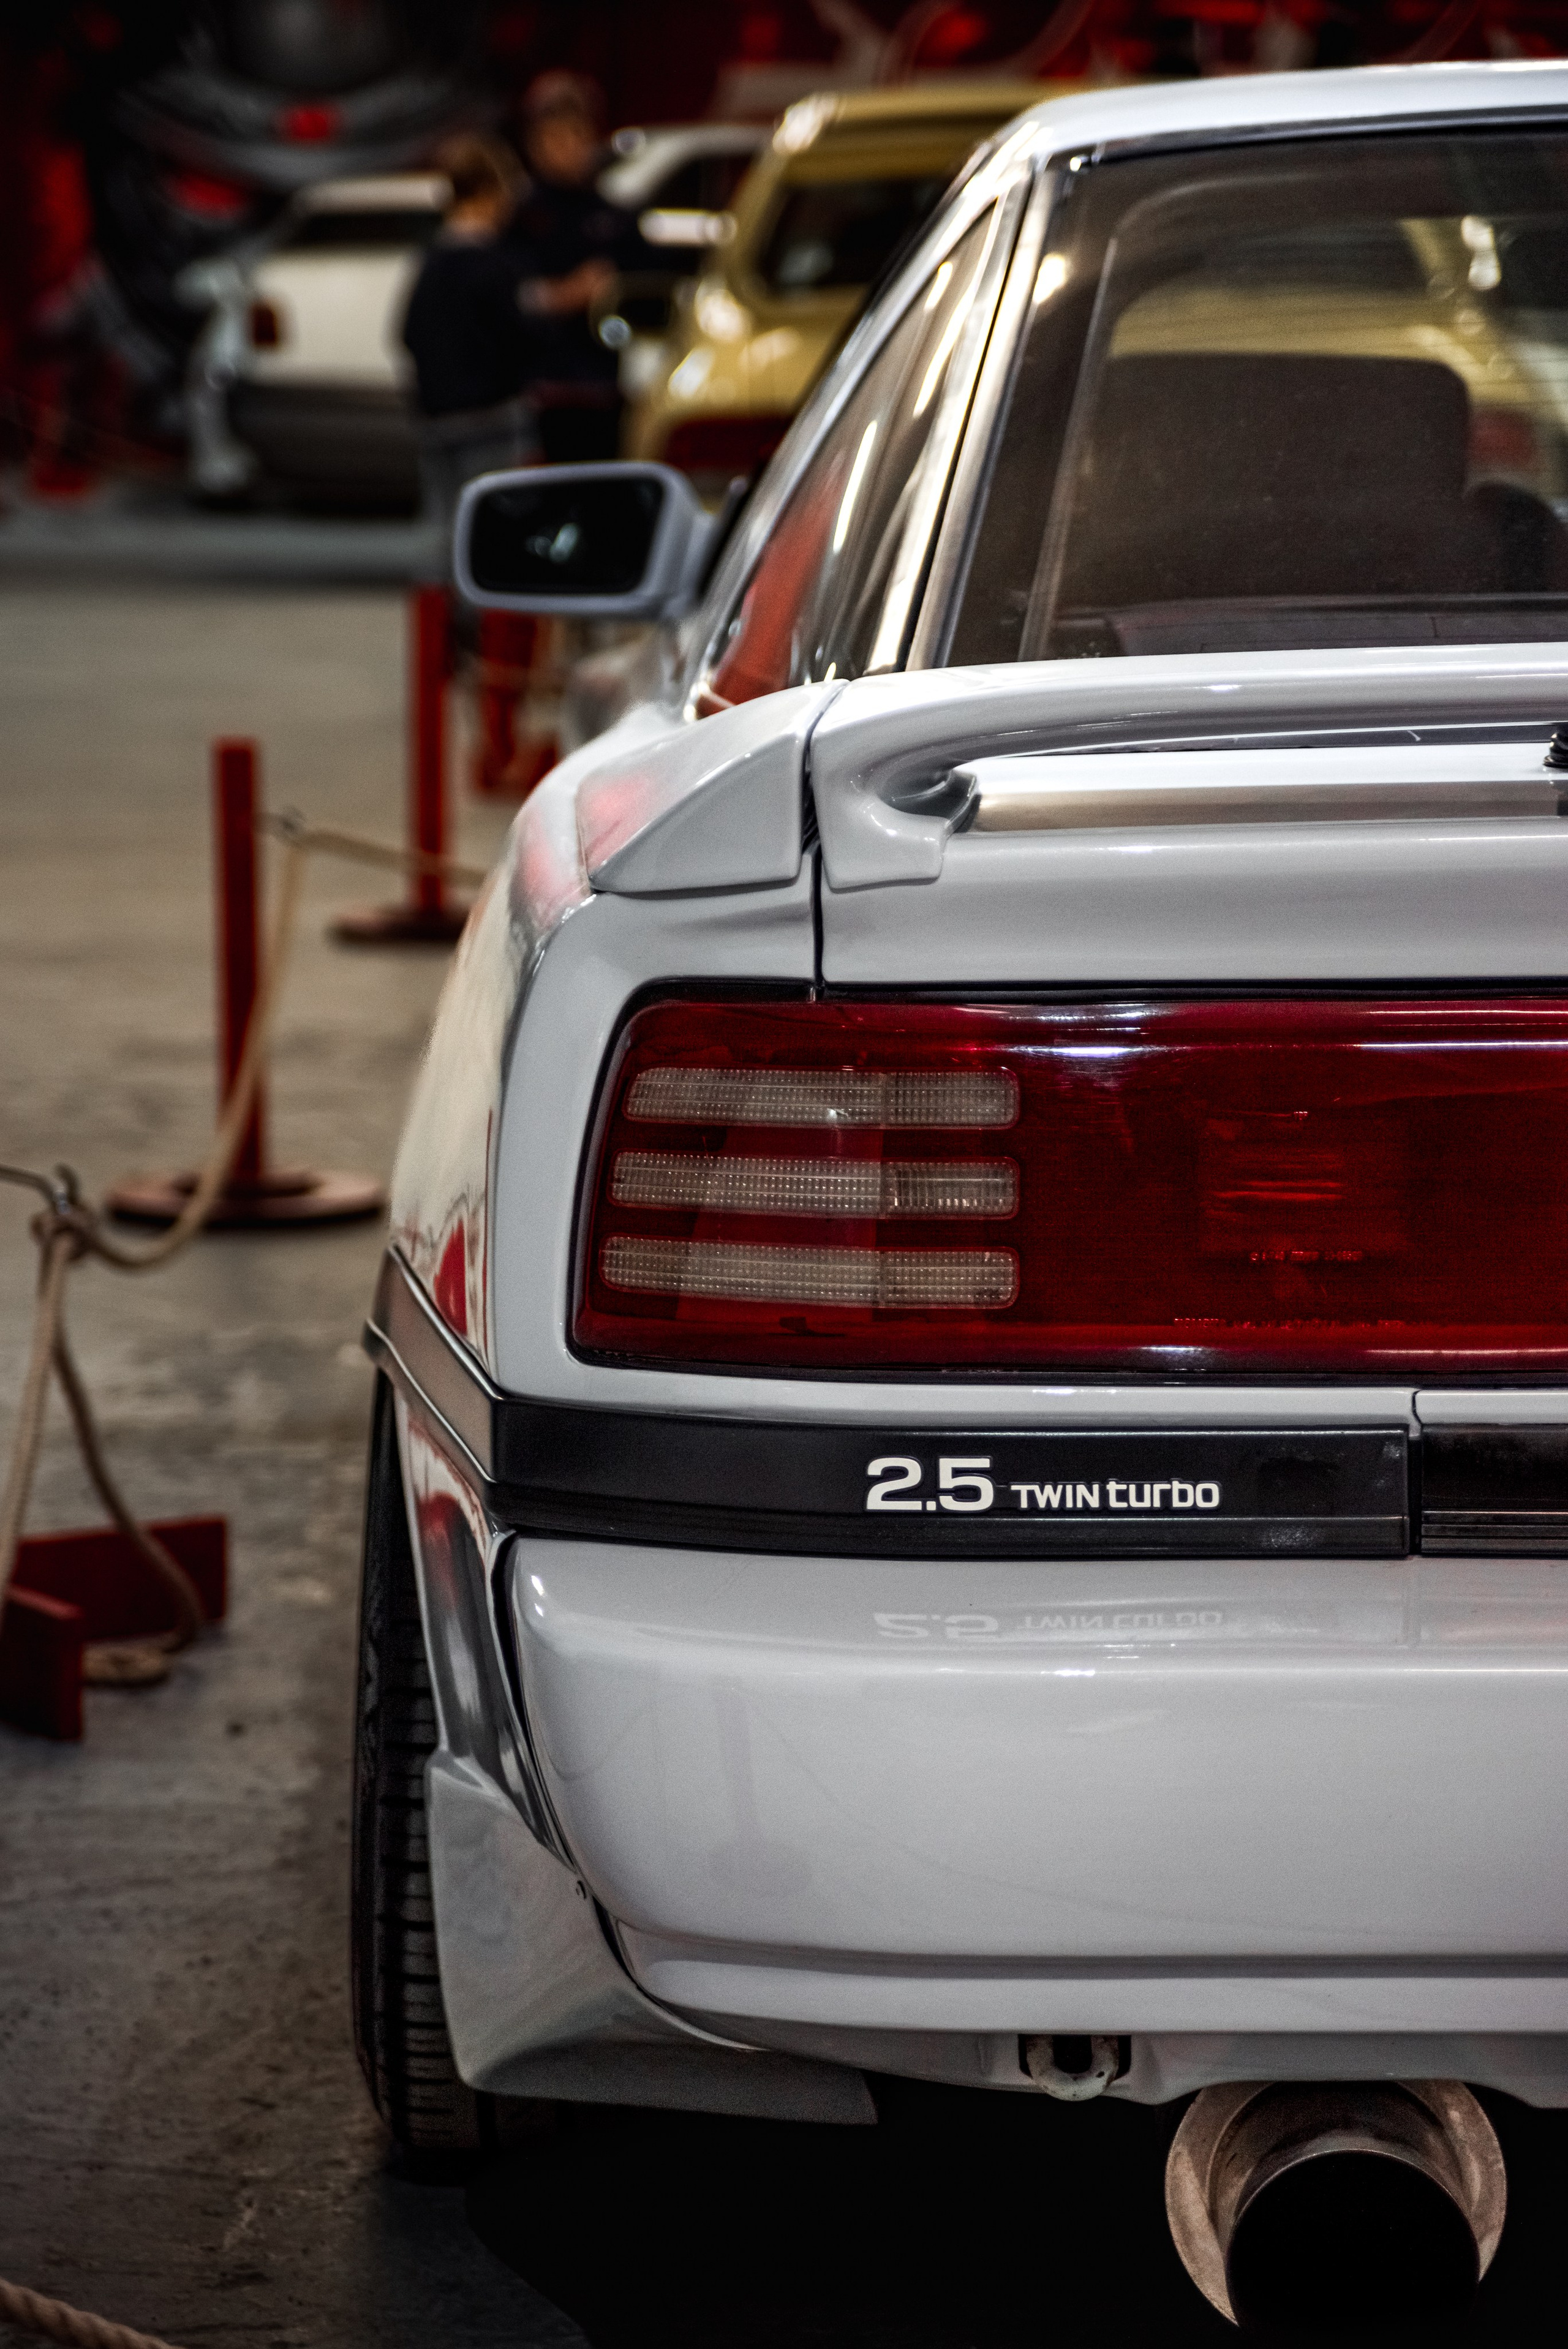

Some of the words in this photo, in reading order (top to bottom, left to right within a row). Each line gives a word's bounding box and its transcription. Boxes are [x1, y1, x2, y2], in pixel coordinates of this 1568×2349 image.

[865, 1457, 995, 1512] 2.5
[1010, 1483, 1100, 1509] TWIN
[1105, 1480, 1220, 1509] turbo
